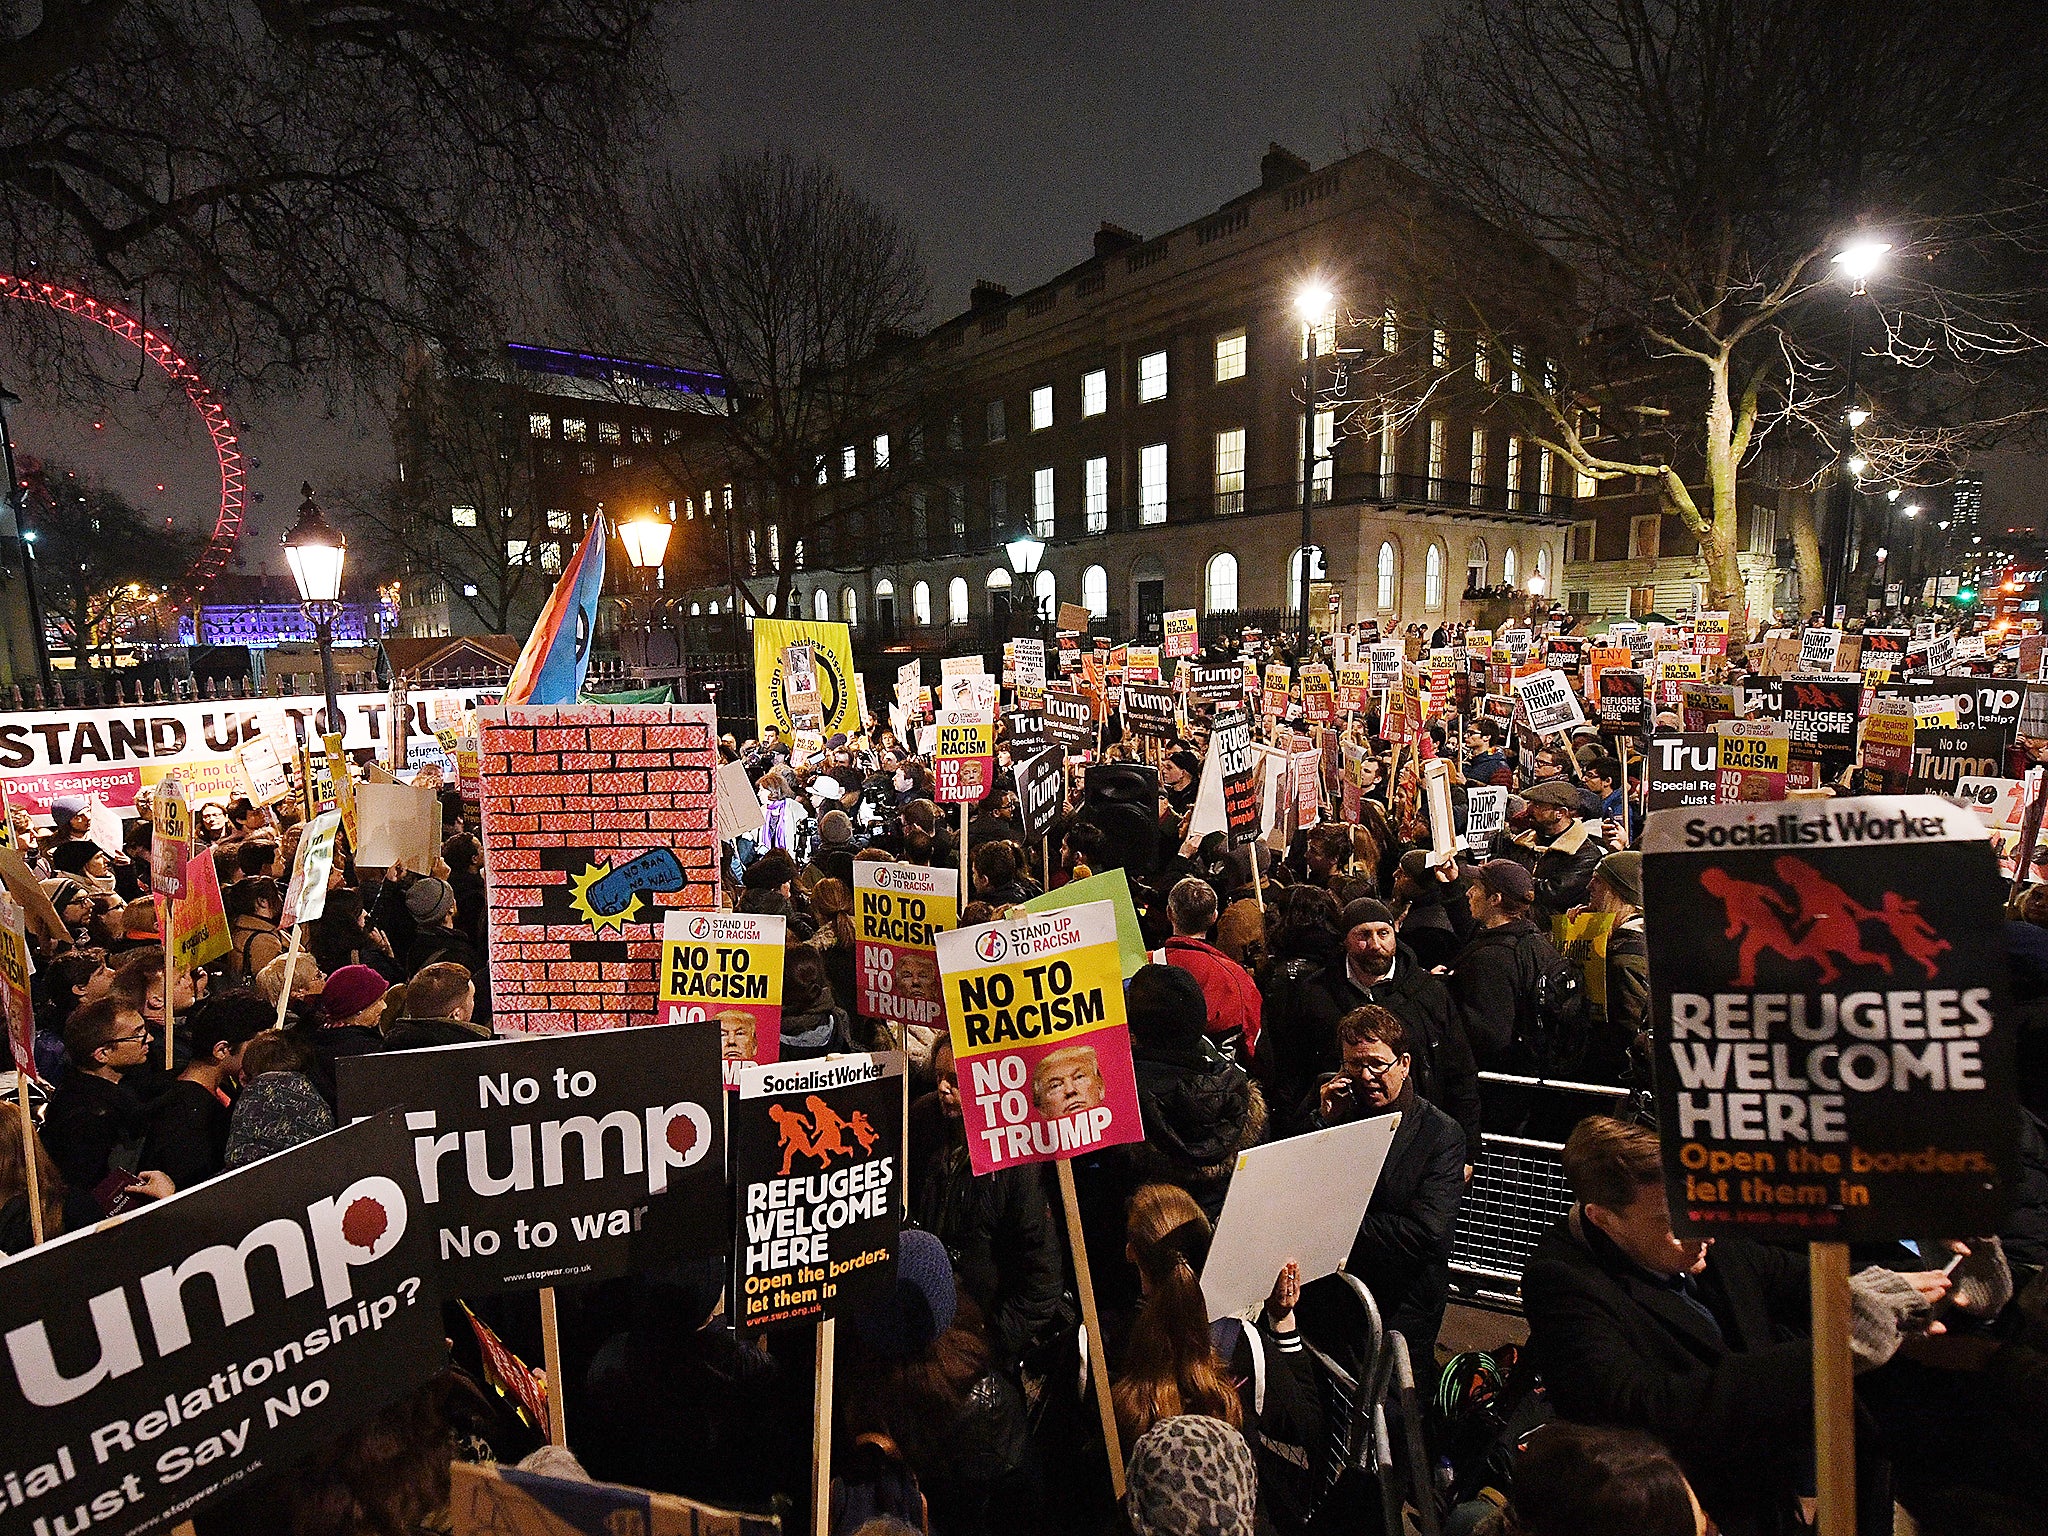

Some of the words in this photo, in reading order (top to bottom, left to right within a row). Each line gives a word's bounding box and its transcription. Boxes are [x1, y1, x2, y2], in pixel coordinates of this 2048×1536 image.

[1167, 625, 1194, 634] RACISM
[1168, 636, 1178, 644] NO
[1506, 635, 1526, 643] DUMP
[1628, 636, 1648, 644] DUMP
[1629, 642, 1652, 650] TRUMP
[1804, 634, 1832, 648] DUMP
[1372, 651, 1396, 662] DUMP
[1592, 649, 1622, 660] TINY
[1802, 646, 1834, 660] TRUMP
[1862, 651, 1904, 659] REFUGEES
[1929, 640, 1950, 656] DUMP
[1190, 666, 1242, 683] Trump
[1372, 662, 1400, 672] TRUMP
[1665, 670, 1696, 678] RACISM
[1678, 664, 1690, 672] TO
[1304, 676, 1312, 684] NO
[1342, 672, 1350, 680] NO
[1342, 678, 1364, 686] RACISM
[768, 668, 790, 734] Campaign
[826, 648, 848, 730] Disarmament
[1522, 680, 1555, 698] DUMP
[1864, 690, 1873, 698] NO
[1124, 688, 1172, 716] Trump
[1523, 690, 1566, 711] TRUMP
[1602, 696, 1642, 705] REFUGEES
[1602, 704, 1640, 714] WELCOME
[1043, 694, 1090, 726] Trump
[1784, 710, 1854, 723] REFUGEES
[1882, 720, 1908, 730] against
[1922, 716, 1940, 726] TO
[0, 718, 187, 768] STAND
[941, 728, 959, 742] NO
[963, 728, 978, 740] TO
[1012, 737, 1034, 746] Special
[941, 741, 986, 755] RACISM
[1724, 739, 1744, 752] NO
[1748, 740, 1767, 754] TO
[1886, 746, 1900, 758] civil
[1940, 738, 1952, 750] No
[1956, 738, 1968, 750] to
[1653, 739, 1716, 771] Tru
[1724, 753, 1778, 770] RACISM
[203, 766, 220, 776] no
[940, 760, 960, 774] NO
[1038, 763, 1046, 778] No
[1916, 748, 1998, 780] Trump
[6, 778, 51, 795] Don't
[54, 771, 135, 791] scapegoat
[322, 781, 332, 790] NO
[940, 774, 958, 786] TO
[1722, 770, 1742, 785] NO
[940, 785, 984, 800] TRUMP
[1028, 769, 1060, 814] Trump
[1652, 780, 1696, 793] Special
[1720, 784, 1740, 798] TO
[1961, 784, 1998, 804] NO
[323, 802, 335, 811] NO
[1470, 796, 1496, 814] DUMP
[1681, 794, 1708, 805] Just
[165, 801, 177, 818] TO
[1034, 815, 1042, 830] No
[1470, 812, 1500, 831] TRUMP
[623, 866, 639, 879] NO
[642, 854, 666, 871] BAN
[630, 878, 644, 891] NO
[650, 872, 681, 887] WALL
[892, 870, 916, 881] STAND
[918, 872, 930, 882] UP
[893, 879, 902, 889] TO
[904, 880, 934, 892] RACISM
[862, 892, 892, 916] NO
[897, 898, 926, 922] TO
[712, 919, 742, 930] STAND
[743, 920, 757, 930] UP
[863, 915, 944, 946] RACISM
[1010, 922, 1052, 944] STAND
[1054, 918, 1072, 934] UP
[712, 928, 724, 940] TO
[725, 930, 761, 940] RACISM
[1012, 942, 1030, 957] TO
[1033, 930, 1081, 954] RACISM
[672, 946, 708, 972] NO
[716, 948, 750, 972] TO
[864, 945, 894, 971] NO
[670, 973, 768, 1000] RACISM
[864, 968, 892, 994] TO
[958, 972, 1015, 1013] NO
[1023, 960, 1074, 1002] TO
[865, 990, 942, 1024] TRUMP
[1670, 987, 1994, 1042] REFUGEES
[964, 988, 1106, 1048] RACISM
[1669, 1040, 1987, 1093] WELCOME
[970, 1055, 1028, 1096] NO
[478, 1072, 540, 1110] No
[552, 1066, 598, 1100] to
[975, 1090, 1030, 1128] TO
[1677, 1092, 1849, 1144] HERE
[981, 1106, 1113, 1164] TRUMP
[1680, 1142, 1776, 1175] Open
[1788, 1147, 1842, 1175] the
[747, 1156, 893, 1215] REFUGEES
[1686, 1175, 1729, 1203] let
[1740, 1177, 1828, 1205] them
[1839, 1178, 1870, 1206] in
[745, 1186, 888, 1245] WELCOME
[438, 1225, 501, 1260] No
[514, 1218, 558, 1251] to
[571, 1204, 649, 1243] war
[746, 1232, 829, 1277] HERE
[503, 1263, 592, 1282] www.stopwar.org.uk
[744, 1273, 793, 1296] Open
[798, 1263, 825, 1285] the
[829, 1246, 891, 1278] borders,
[5, 1176, 407, 1407] ump
[746, 1293, 770, 1316] let
[773, 1286, 818, 1310] them
[822, 1282, 838, 1299] in
[746, 1303, 822, 1328] www.swp.org.uk
[90, 1276, 420, 1464] Relationship?
[155, 1418, 250, 1484] Say
[264, 1378, 330, 1429] No
